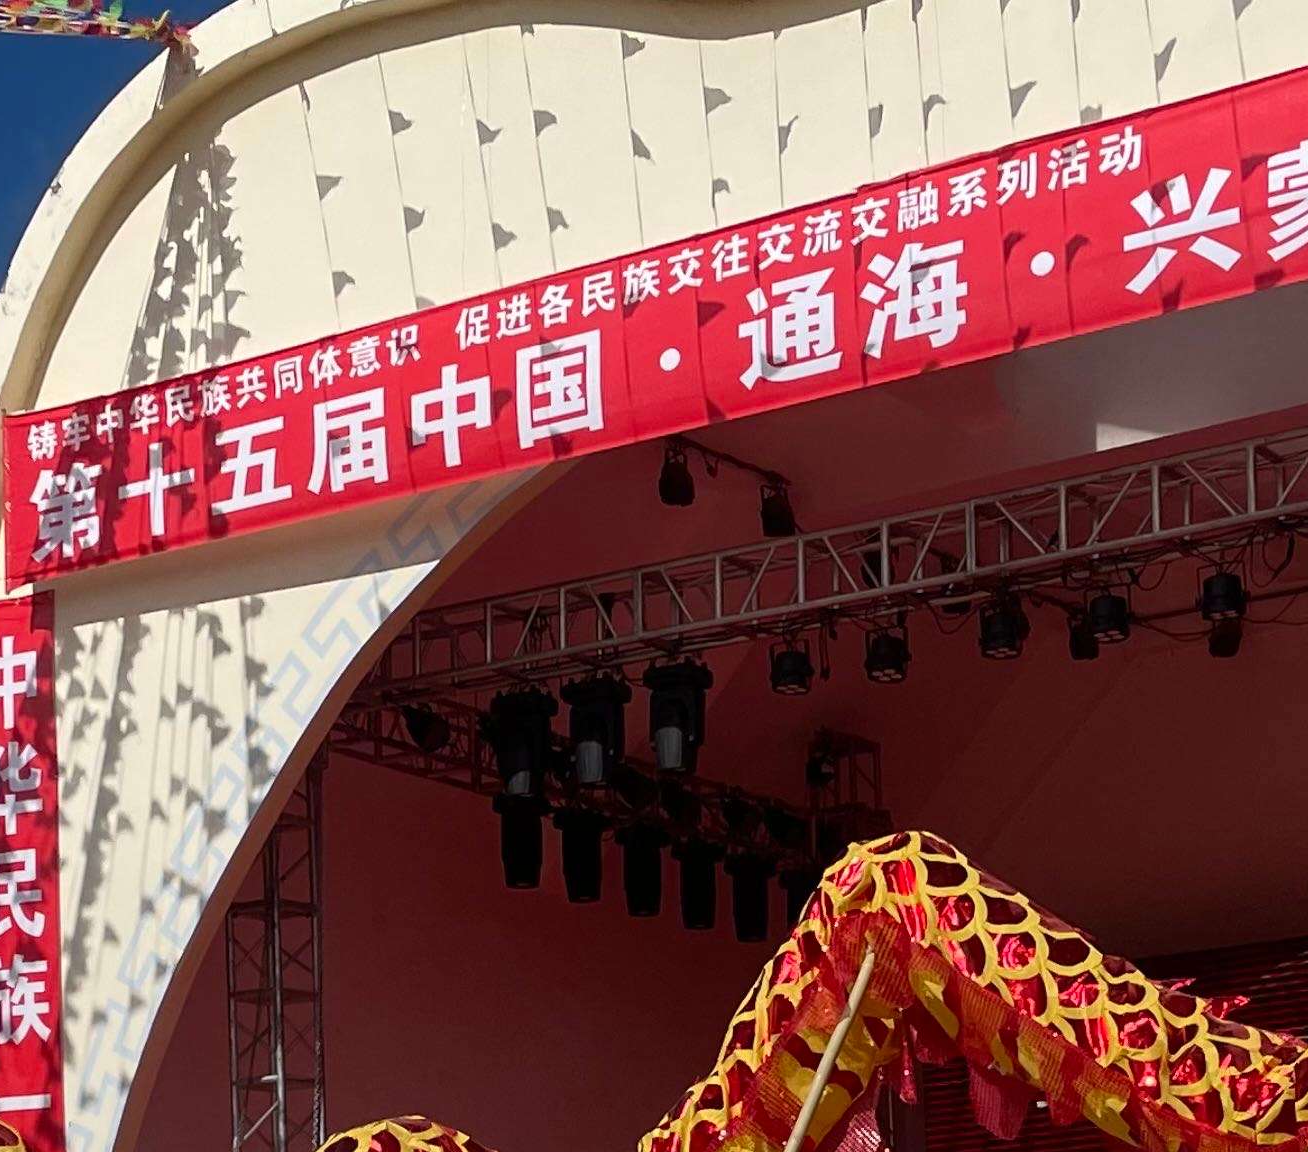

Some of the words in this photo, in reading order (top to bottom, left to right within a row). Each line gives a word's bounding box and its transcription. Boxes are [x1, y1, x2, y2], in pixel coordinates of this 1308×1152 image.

[27, 324, 421, 461] 铸牢中华民族共同体意识
[455, 125, 1143, 350] 促进各民族交往交流交融系列活动
